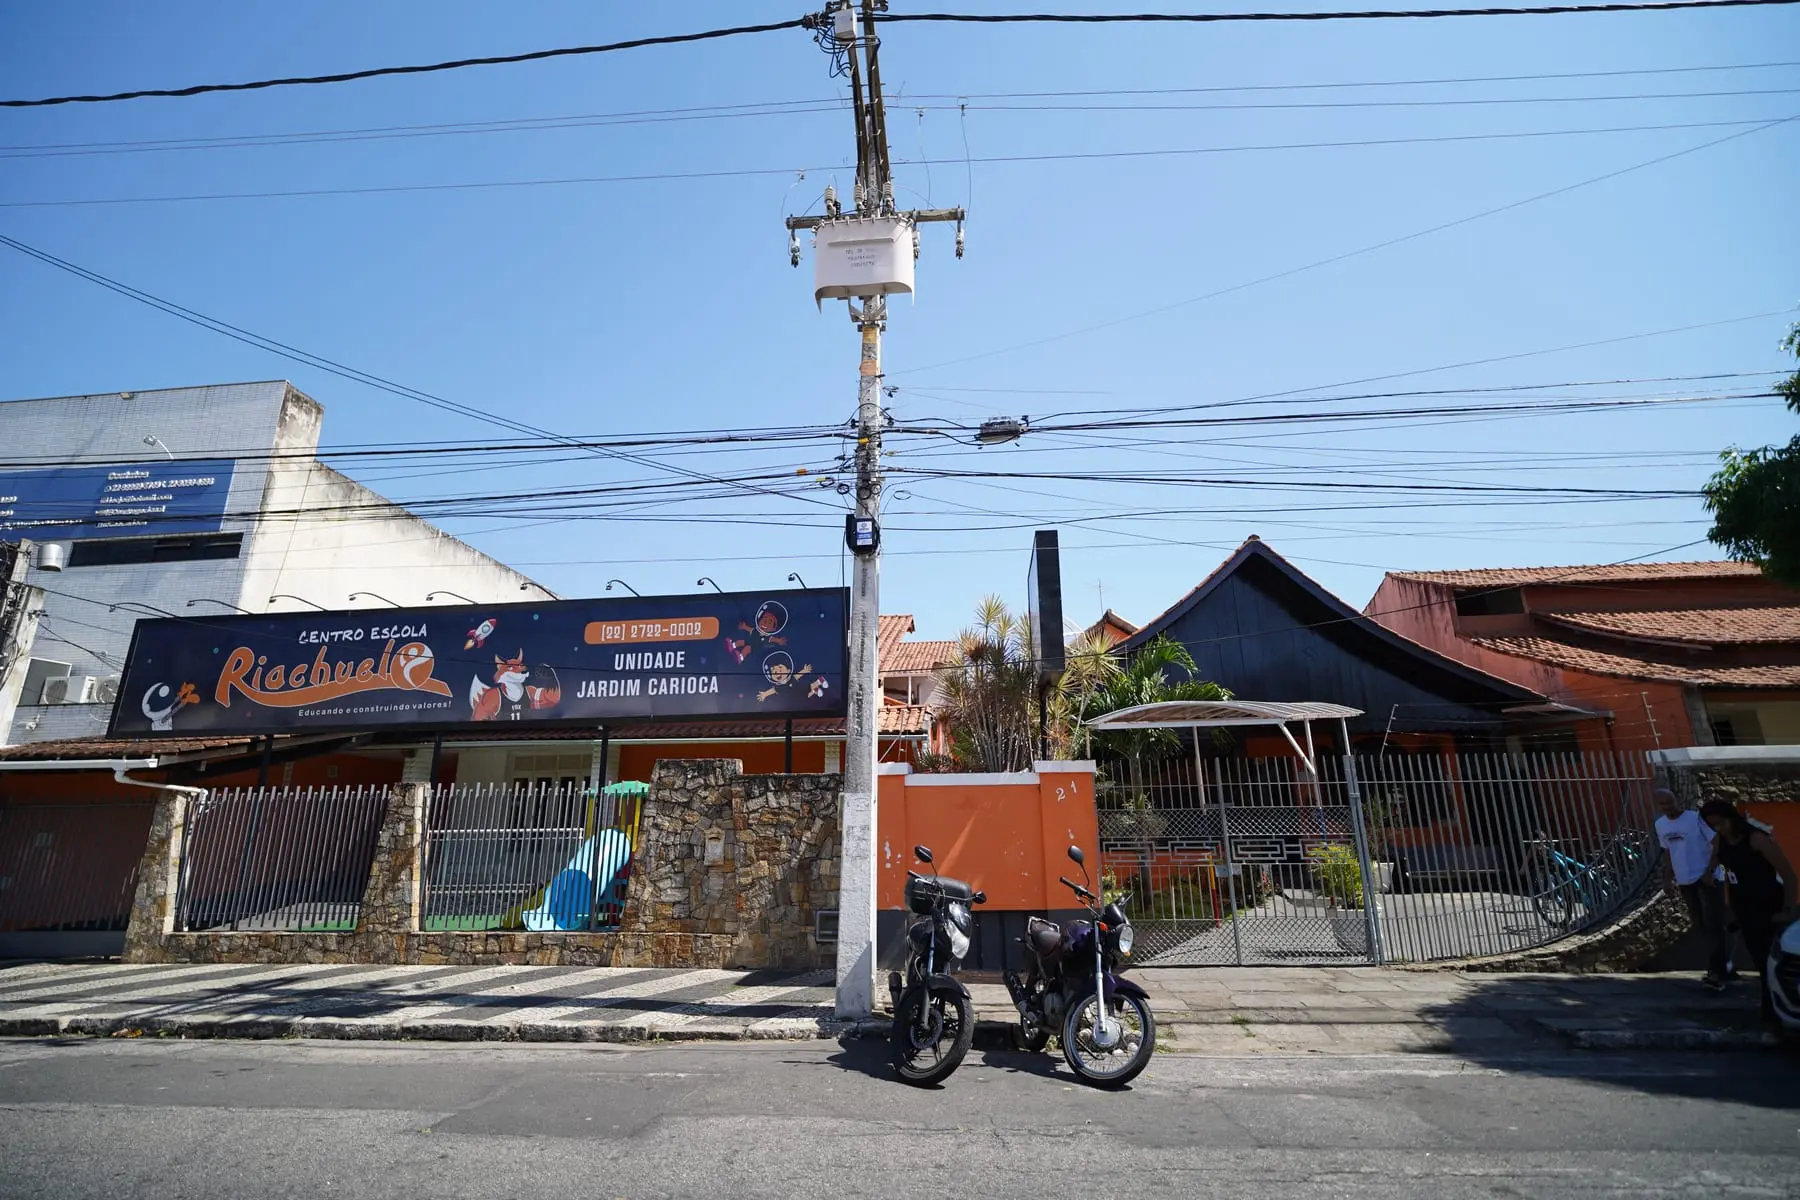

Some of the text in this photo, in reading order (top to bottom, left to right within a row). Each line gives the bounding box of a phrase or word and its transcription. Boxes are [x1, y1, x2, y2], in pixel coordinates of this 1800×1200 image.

[298, 624, 427, 643] CENTRO ESCOLA
[631, 622, 702, 638] 2722-0002
[614, 651, 685, 671] UNIDADE
[576, 676, 719, 698] JARDIM CARIOCA
[299, 705, 343, 717] Educando
[353, 702, 410, 714] construindo
[412, 700, 452, 710] valores!
